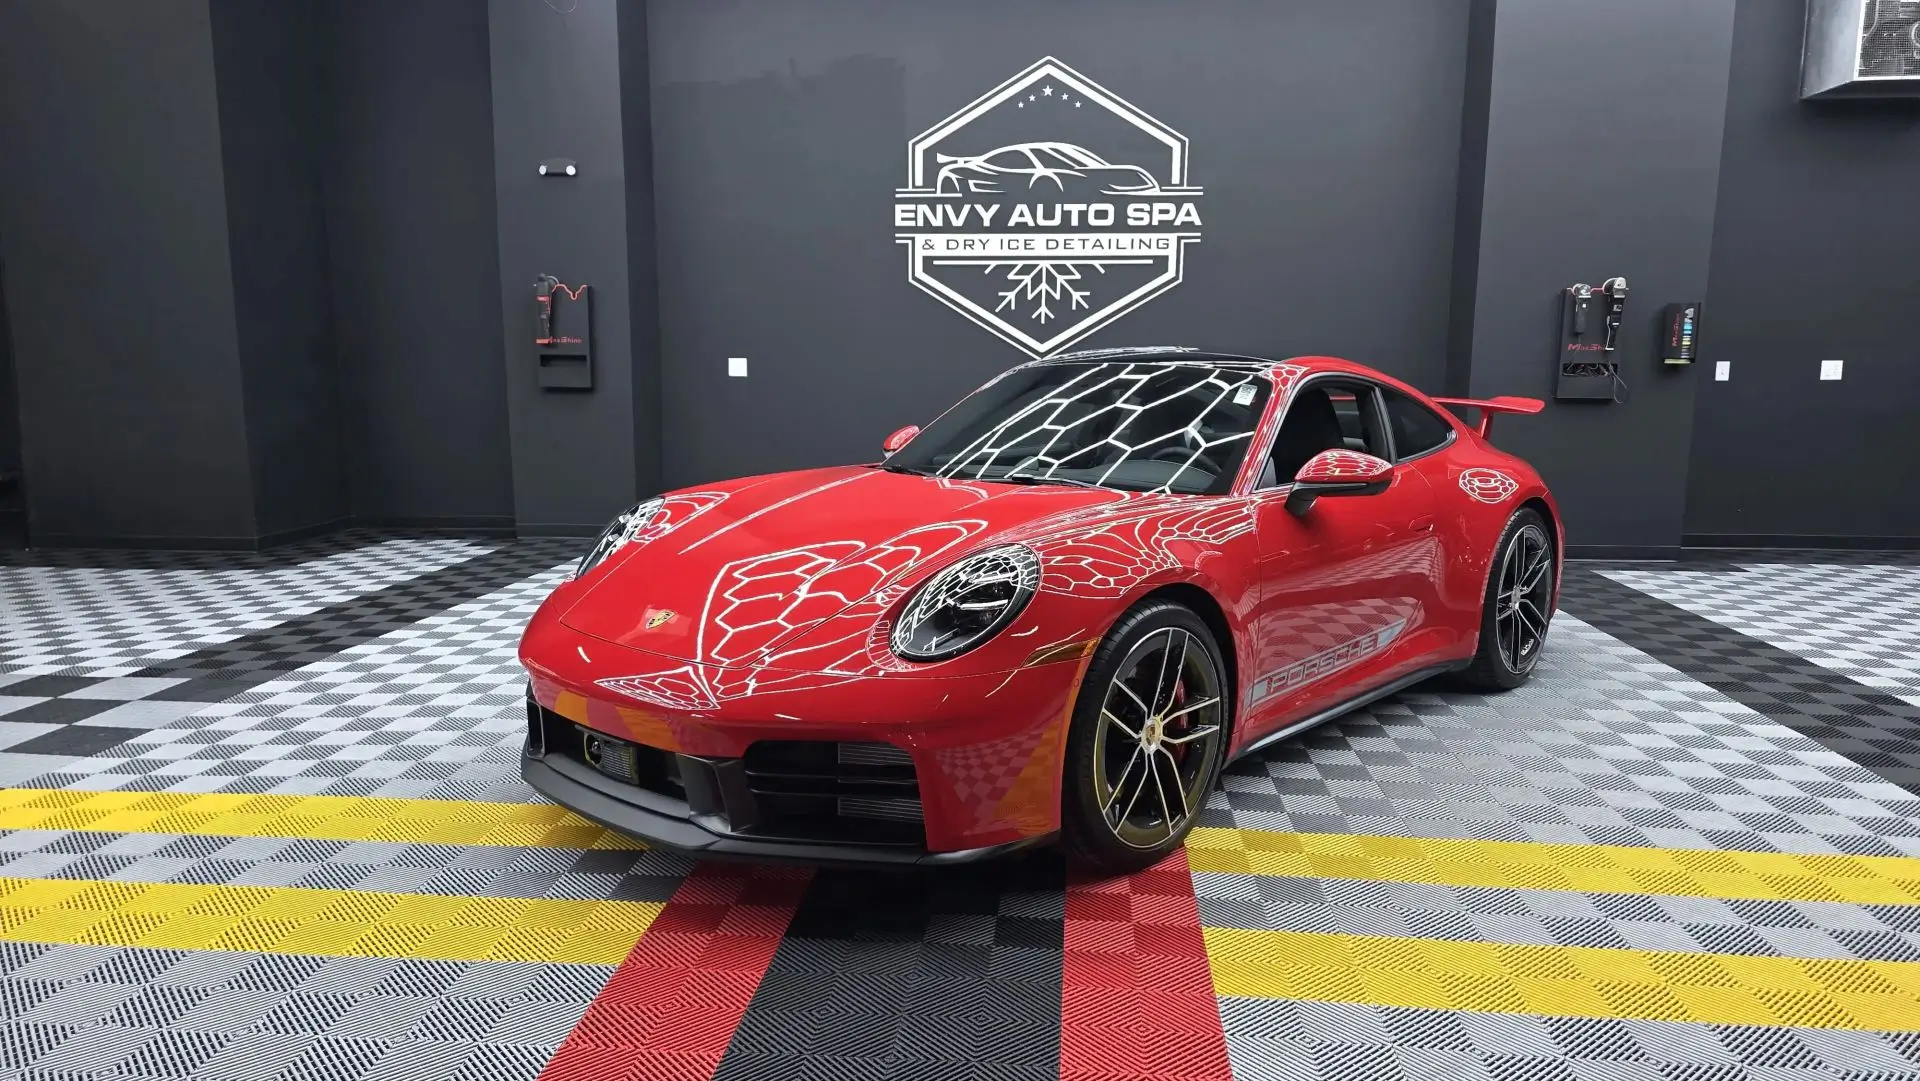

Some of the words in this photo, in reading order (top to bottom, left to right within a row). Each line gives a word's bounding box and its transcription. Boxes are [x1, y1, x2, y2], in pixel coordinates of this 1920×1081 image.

[895, 203, 1000, 226] ENVY
[1007, 203, 1114, 226] AUTO
[1126, 202, 1202, 226] SPA
[922, 239, 935, 250] &
[945, 239, 990, 250] DRY
[1000, 239, 1035, 250] ICE
[1045, 238, 1170, 250] DETAILING
[1269, 633, 1377, 692] PORSCHE
